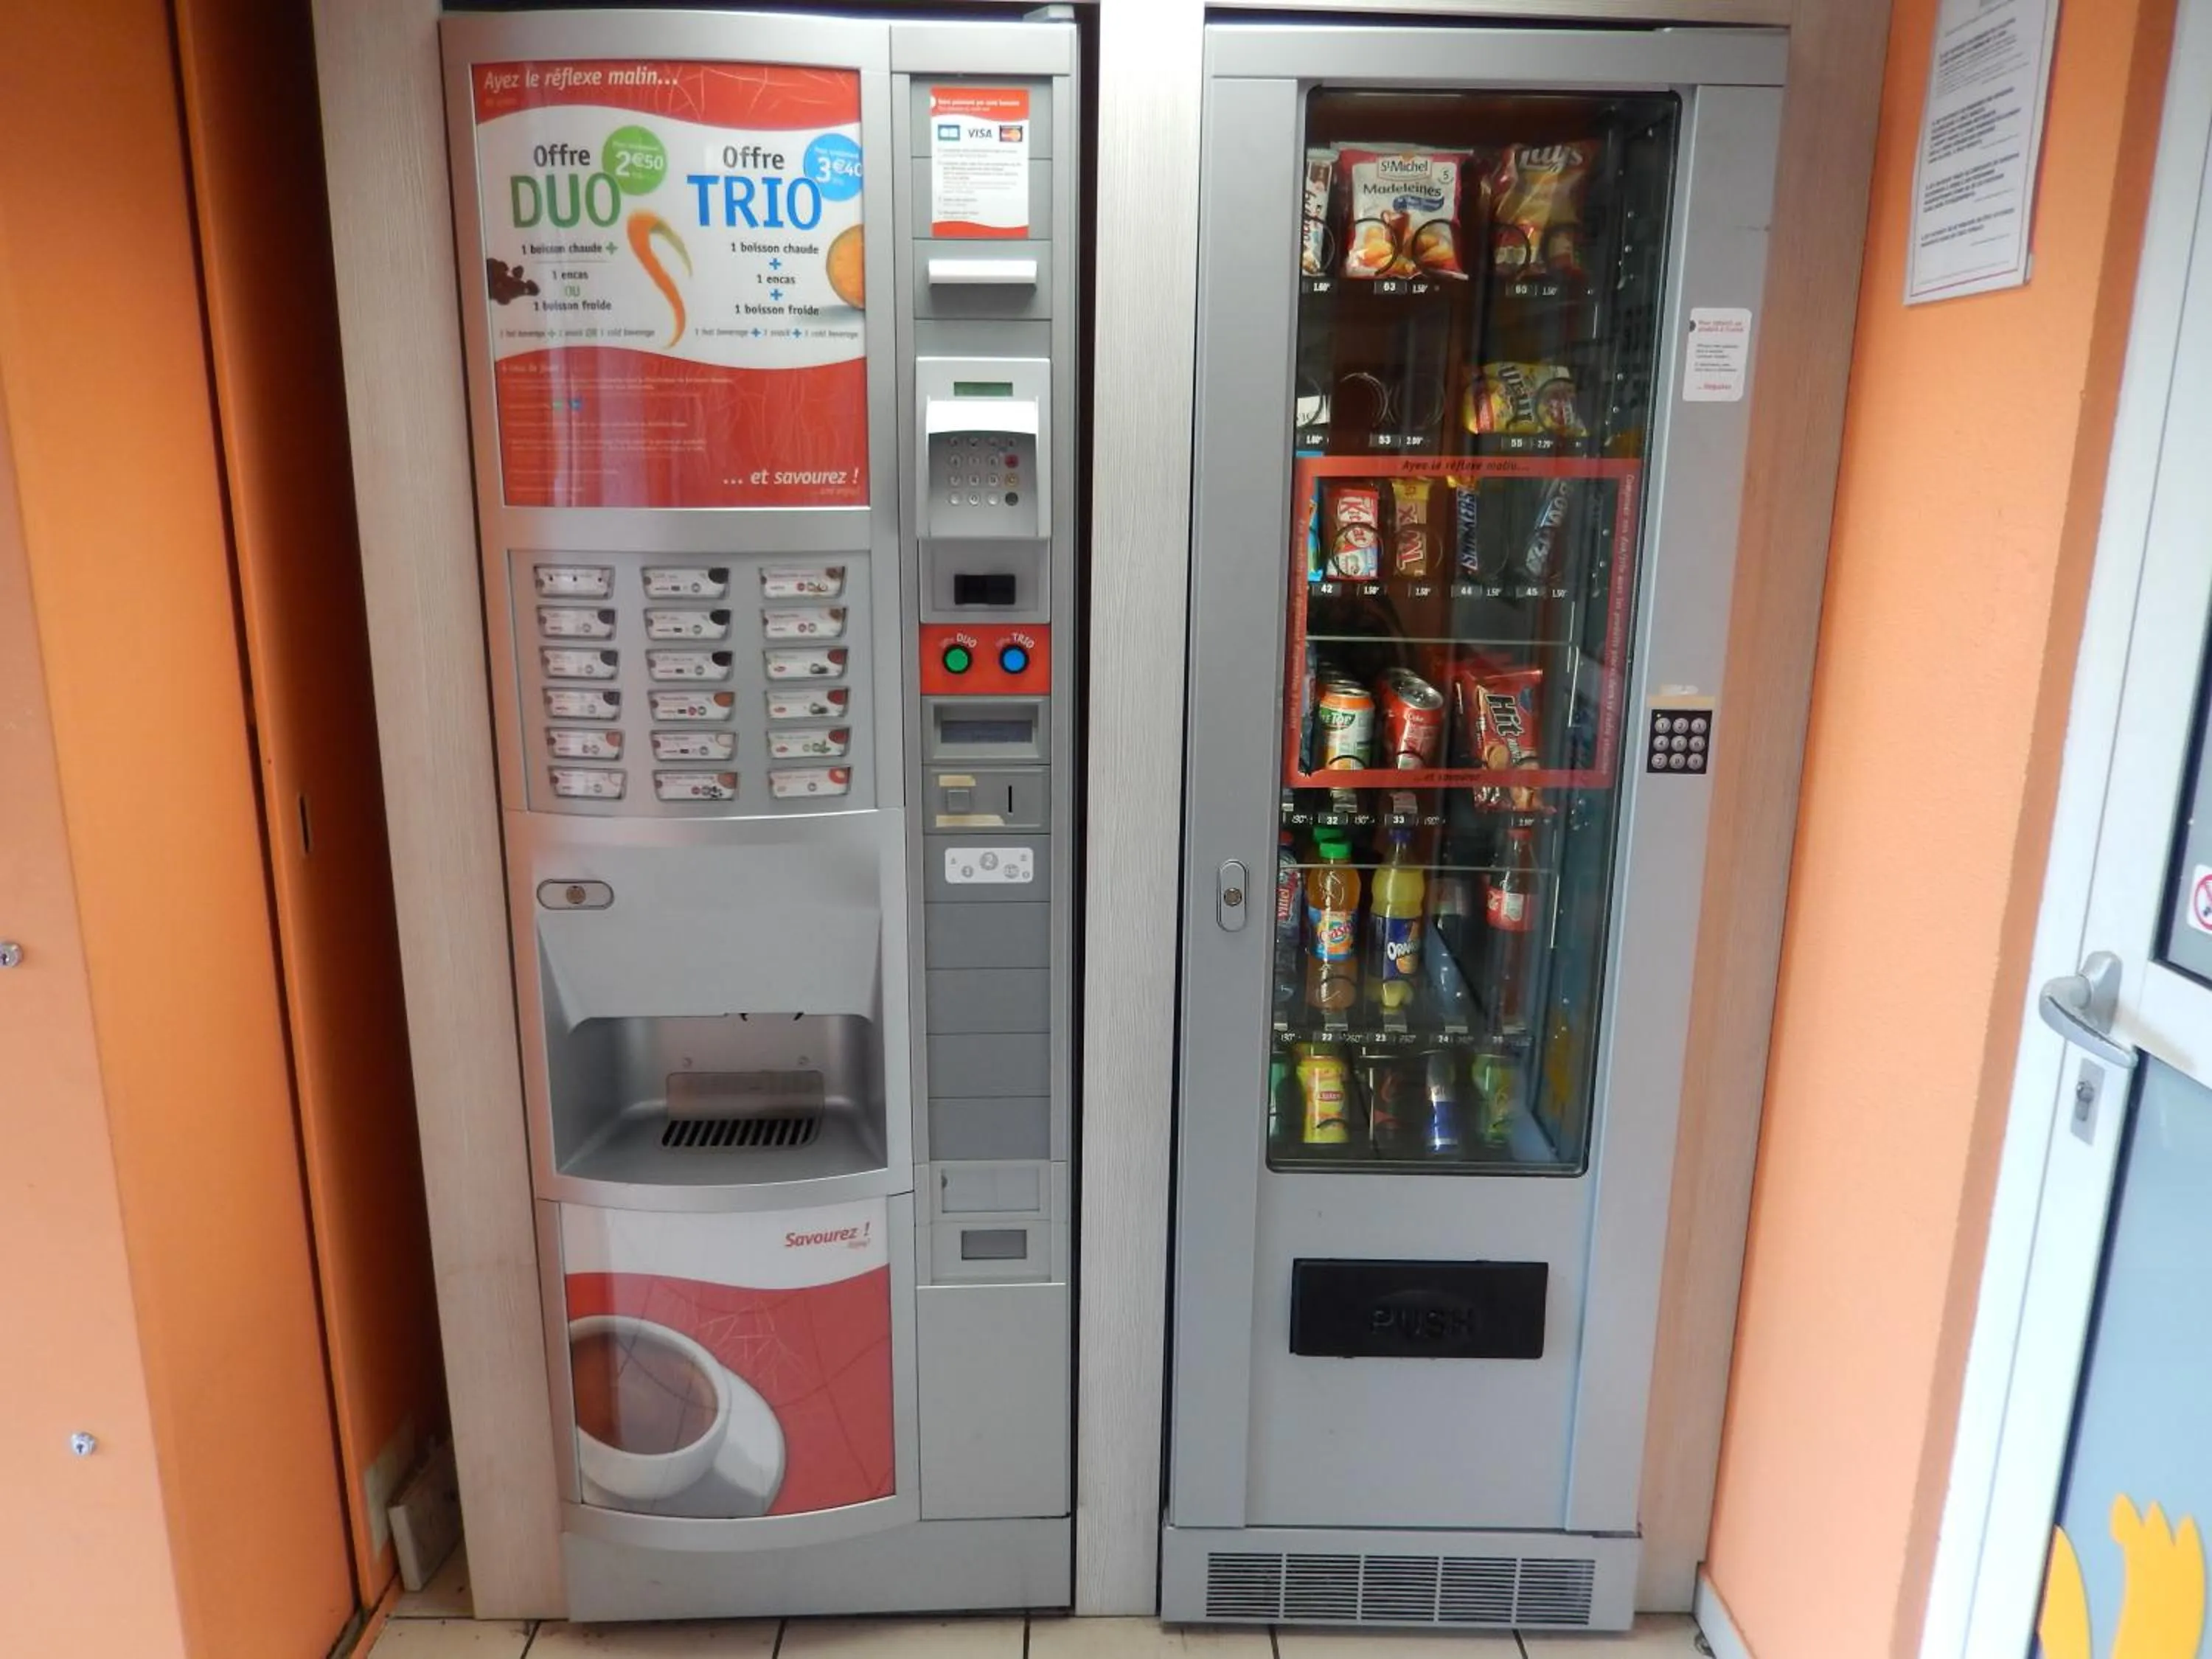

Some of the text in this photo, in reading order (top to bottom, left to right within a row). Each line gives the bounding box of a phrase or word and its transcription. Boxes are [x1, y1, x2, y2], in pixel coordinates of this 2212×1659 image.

[484, 72, 519, 94] Ayez
[525, 70, 539, 88] le
[545, 68, 602, 91] réflexe
[968, 129, 992, 138] VISA
[534, 144, 590, 167] Offre
[723, 145, 785, 170] Offre
[1443, 170, 1449, 180] 5
[1364, 184, 1441, 197] Madeleines
[510, 172, 622, 229] DUO
[686, 175, 821, 230] TRIO
[568, 243, 602, 254] chaude
[740, 242, 779, 254] boisson
[784, 243, 819, 254] chaude
[561, 271, 589, 280] encas
[767, 276, 796, 285] encas
[582, 300, 611, 311] froide
[745, 305, 784, 315] boisson
[788, 305, 819, 316] froide
[751, 469, 769, 484] et
[773, 470, 847, 485] savourez
[1321, 584, 1332, 594] 42
[956, 633, 977, 648] DUO
[1012, 633, 1034, 649] TRIO
[1326, 816, 1338, 825] 32
[1393, 815, 1405, 824] 33
[785, 1227, 858, 1247] Savourez
